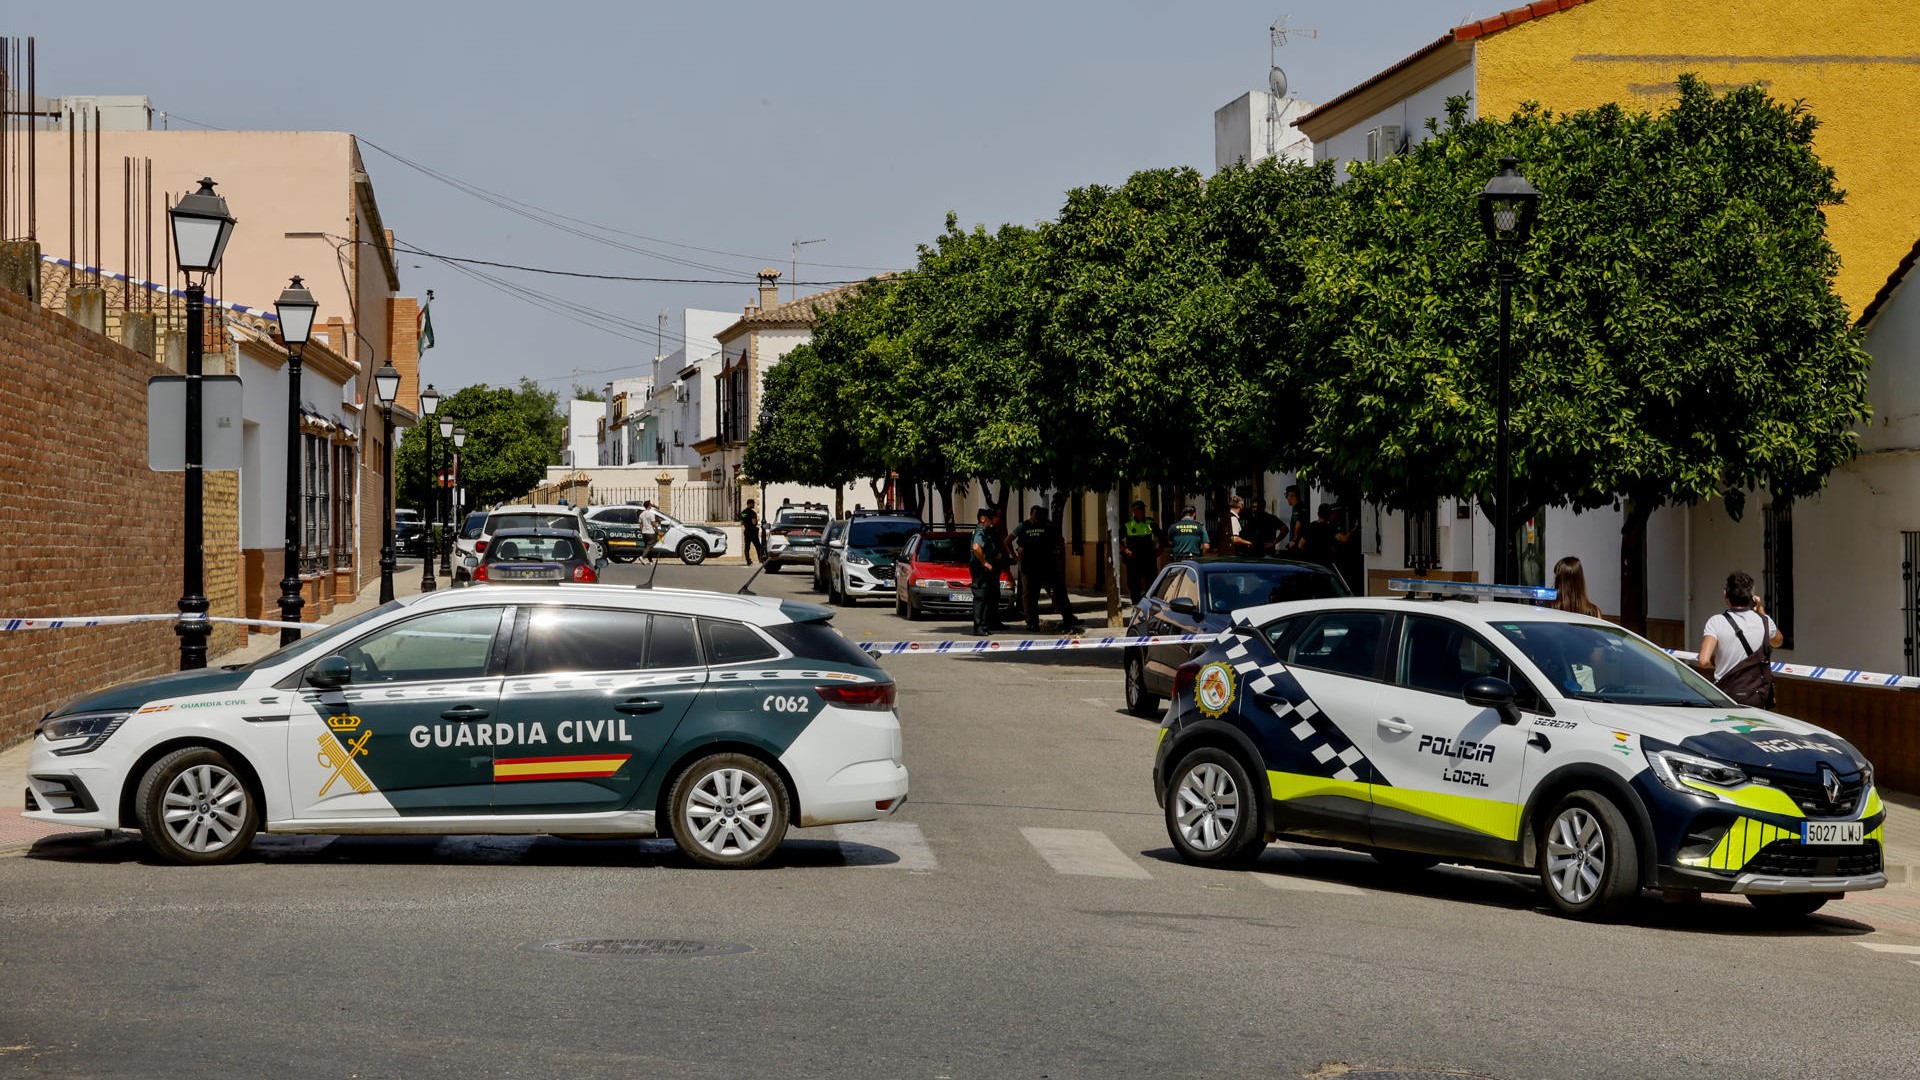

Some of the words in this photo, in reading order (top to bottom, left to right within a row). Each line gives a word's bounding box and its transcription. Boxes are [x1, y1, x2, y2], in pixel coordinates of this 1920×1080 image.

[180, 701, 222, 710] GUARDIA
[775, 695, 809, 713] 062
[409, 721, 548, 748] GUARDIA
[556, 719, 633, 744] CIVIL
[1418, 734, 1496, 763] POLICIA
[1442, 768, 1489, 788] LOCAL
[1808, 825, 1837, 842] 5027
[1840, 825, 1861, 842] LWJ
